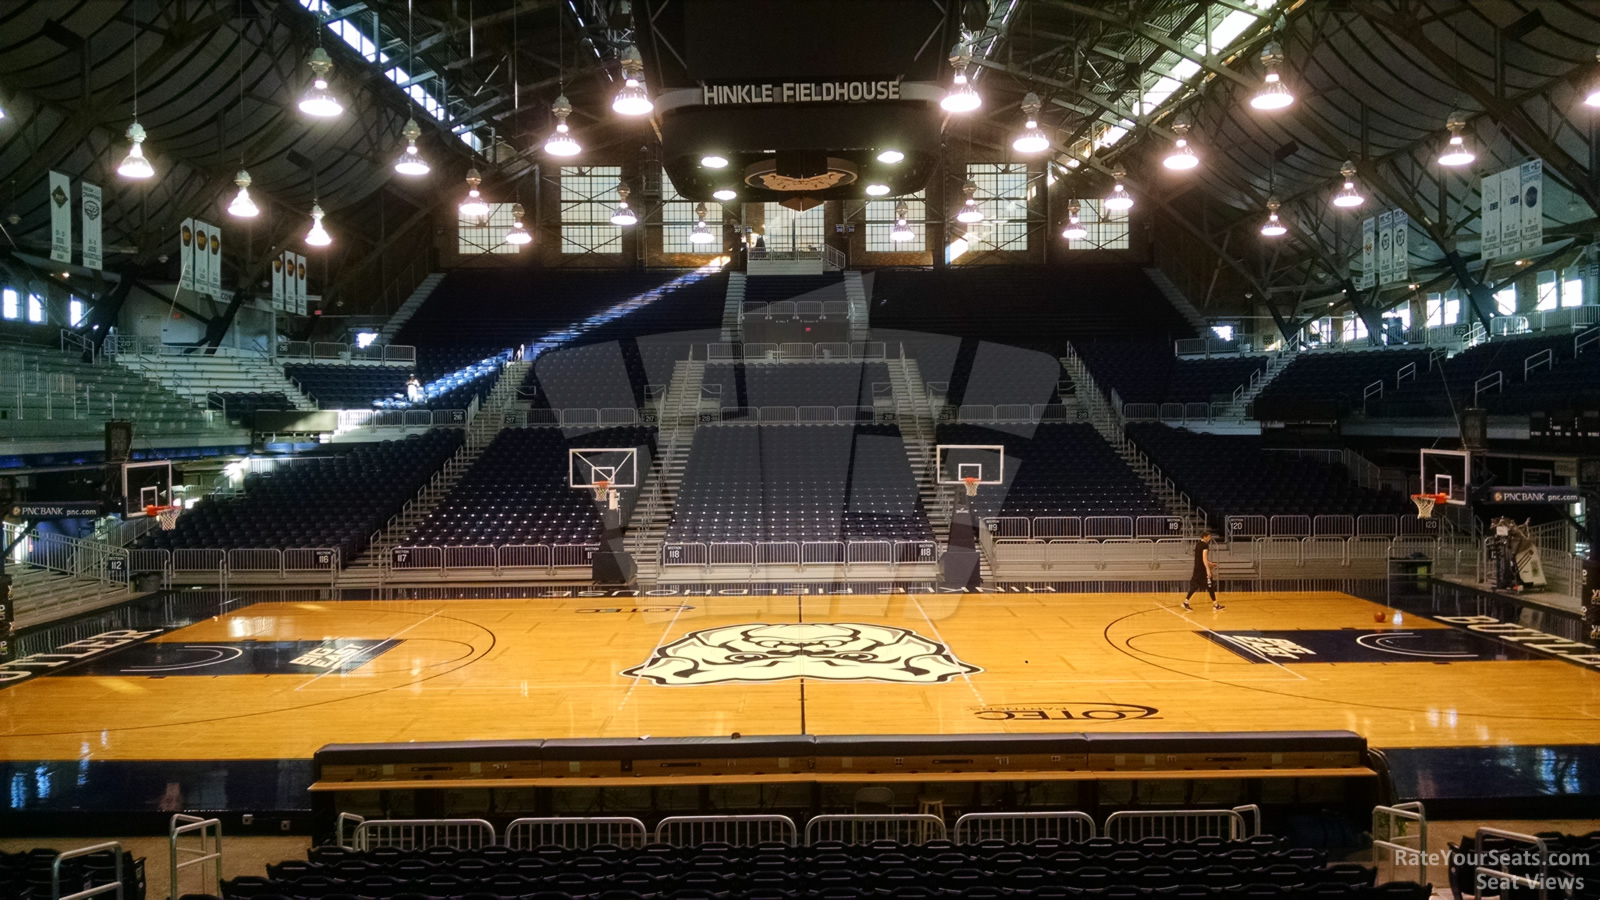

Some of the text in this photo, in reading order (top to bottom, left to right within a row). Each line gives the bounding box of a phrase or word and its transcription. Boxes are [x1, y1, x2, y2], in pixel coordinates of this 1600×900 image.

[704, 81, 899, 105] HINKLE FIELDHOUSE
[1547, 494, 1578, 502] pnc.com
[66, 509, 97, 517] pnc.com
[1169, 522, 1179, 530] 119
[1425, 521, 1437, 529] 120
[669, 550, 680, 558] 118
[920, 548, 931, 556] 118
[318, 555, 329, 563] 116
[397, 554, 407, 562] 117
[111, 561, 122, 570] 112
[1433, 615, 1600, 669] BUTLE
[289, 647, 335, 666] BIG
